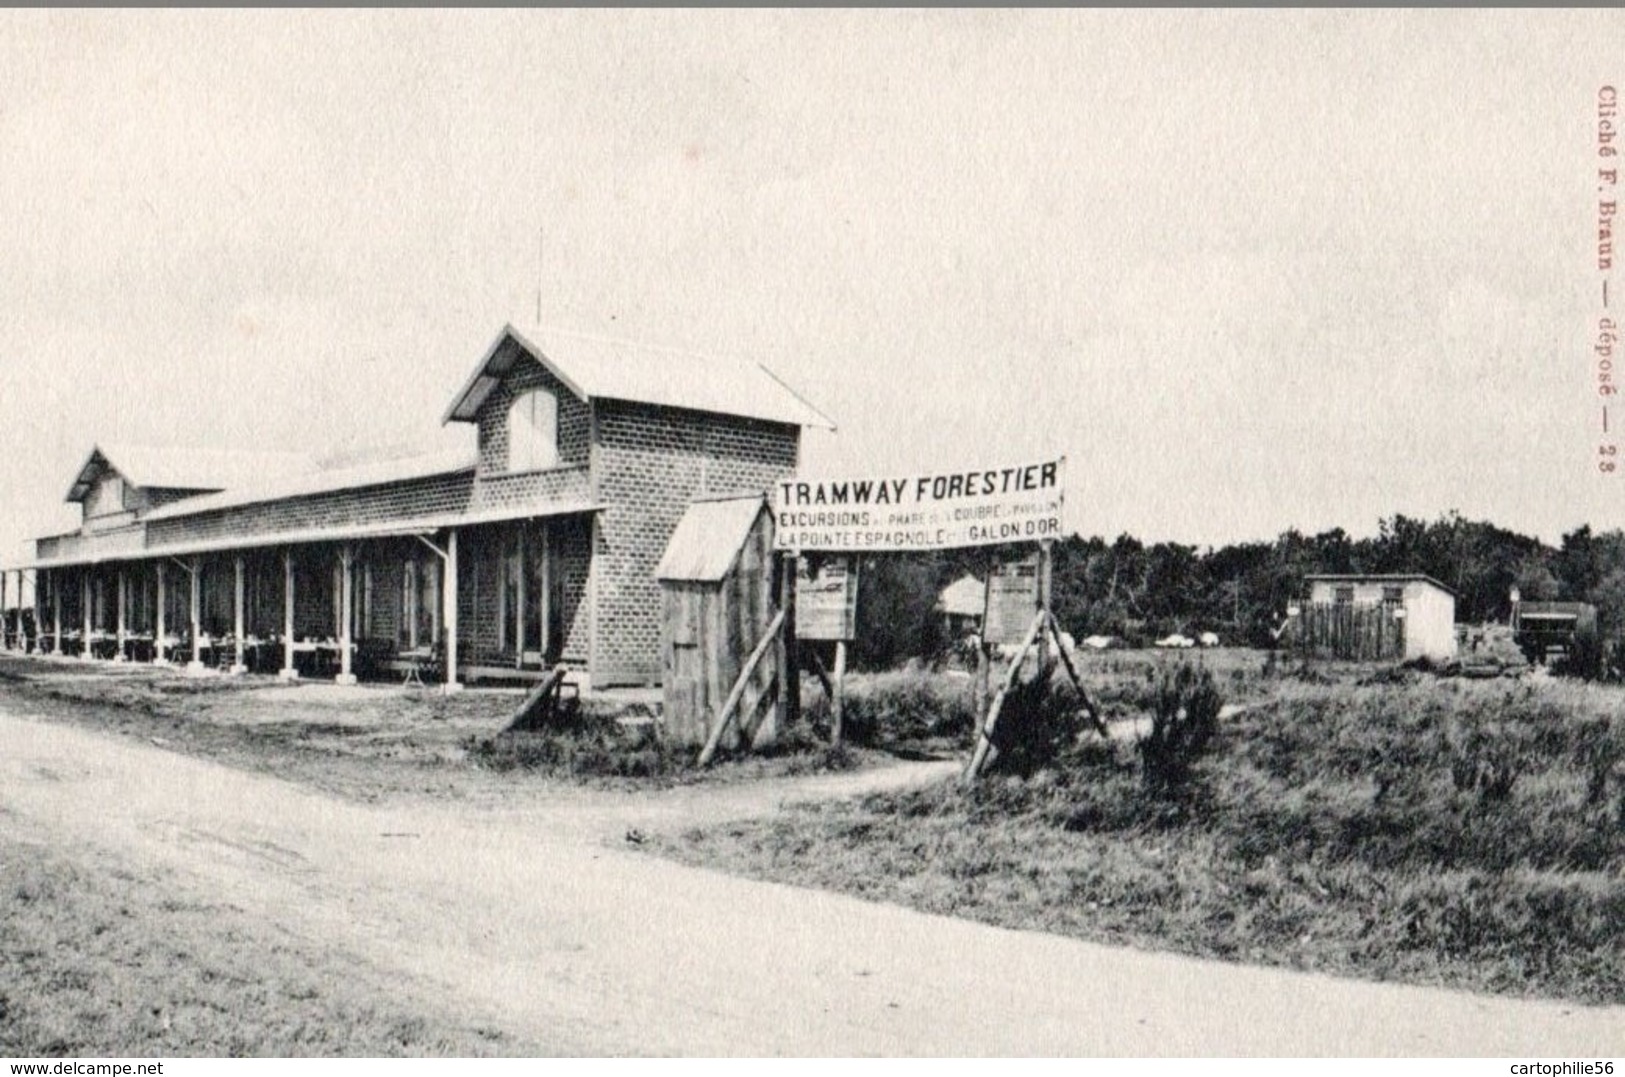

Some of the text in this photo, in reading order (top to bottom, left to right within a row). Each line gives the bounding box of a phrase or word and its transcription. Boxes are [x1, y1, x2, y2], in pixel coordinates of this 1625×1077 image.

[780, 460, 1058, 506] TRAMWAY FORESTIER
[779, 511, 870, 527] EXCURSIONS
[954, 504, 1001, 521] COUBRE
[779, 532, 797, 547] LA
[855, 528, 944, 547] ESPAGNOLE
[969, 521, 1020, 541] GALON
